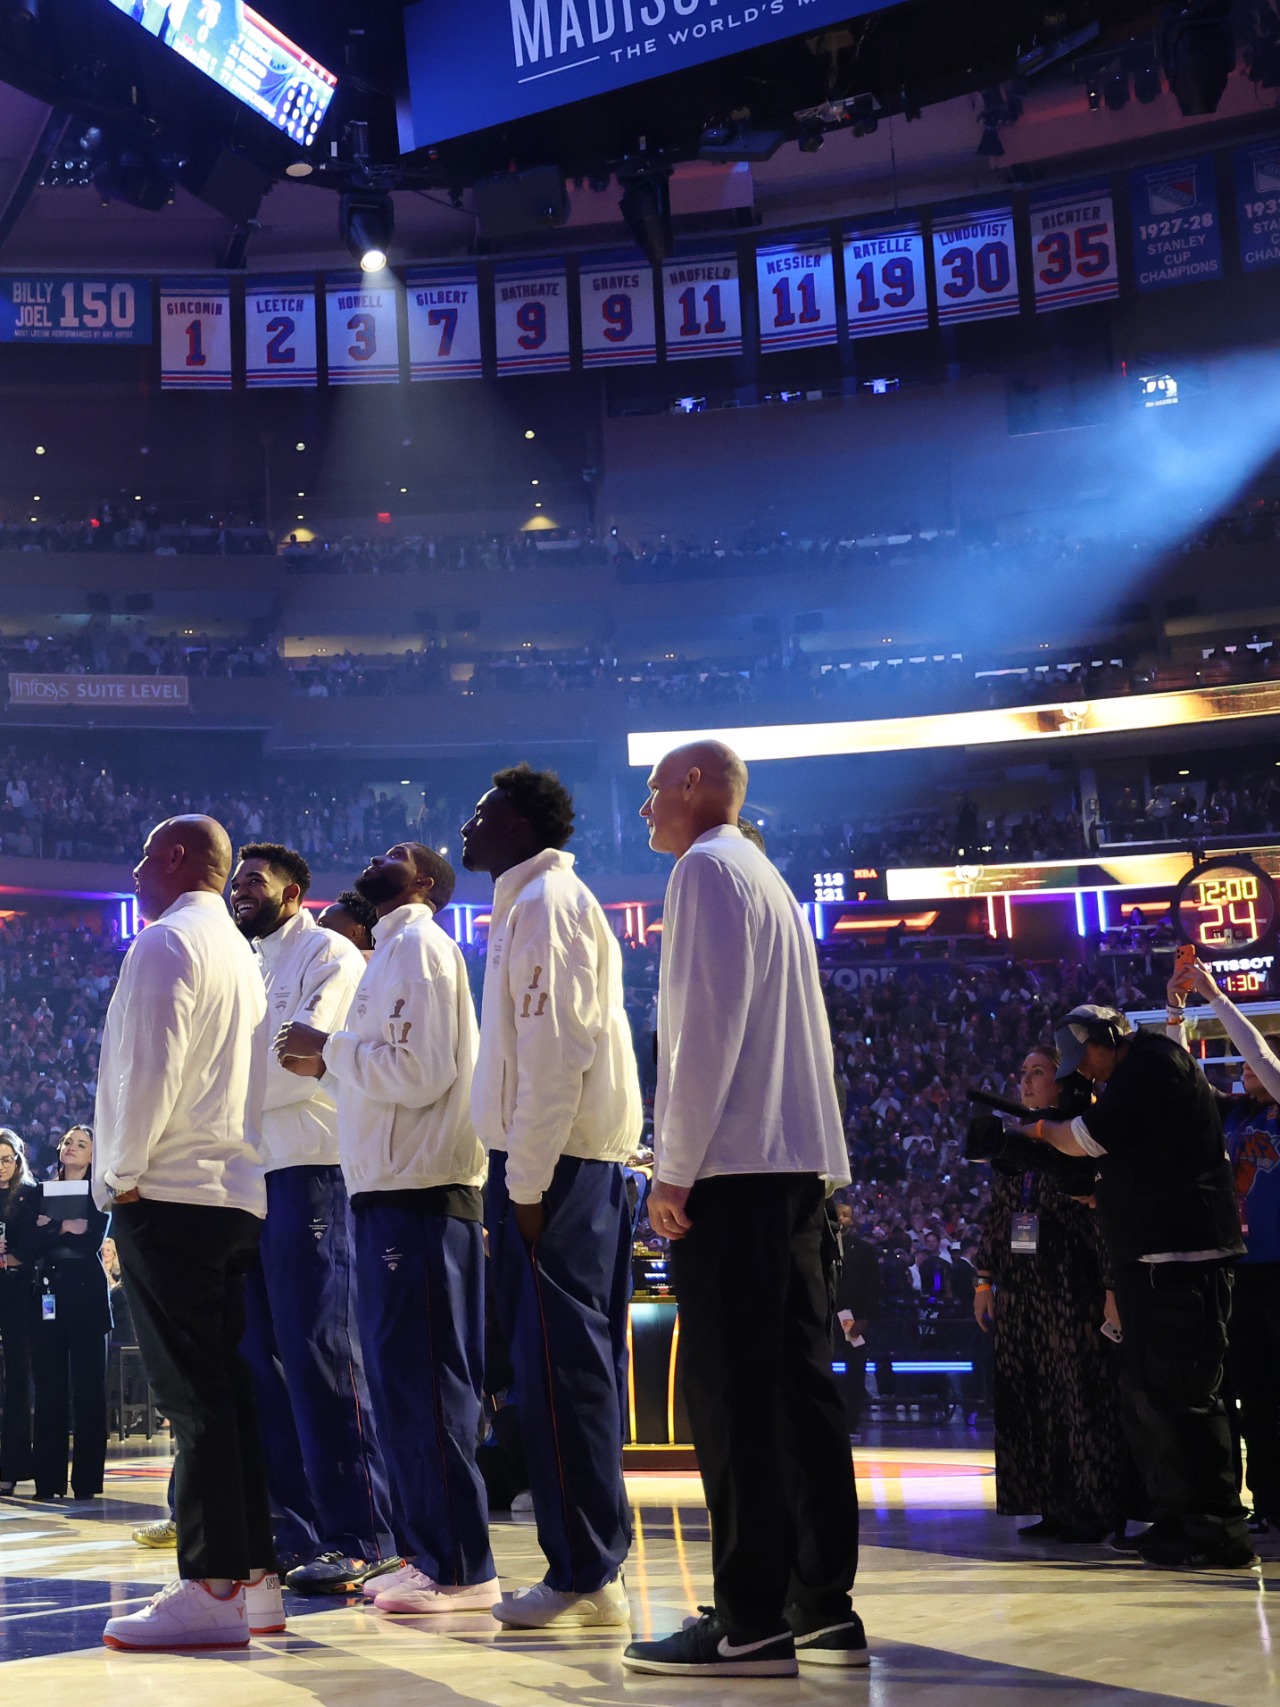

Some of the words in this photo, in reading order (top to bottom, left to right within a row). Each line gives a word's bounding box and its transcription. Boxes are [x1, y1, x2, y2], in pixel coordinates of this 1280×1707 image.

[610, 38, 657, 63] THE
[668, 0, 784, 45] WORLD'S
[1041, 206, 1101, 230] RICHTER
[1140, 213, 1214, 240] 1927-28
[853, 238, 912, 259] RATELLE
[1037, 223, 1110, 285] 35
[1147, 234, 1206, 255] STANLEY
[766, 255, 821, 275] MESSIER
[942, 241, 1010, 298] 30
[1164, 252, 1191, 266] CUP
[592, 275, 639, 291] GRAVES
[670, 267, 731, 284] HADFIELD
[1140, 260, 1218, 284] CHAMPIONS
[12, 282, 54, 303] BILLY
[501, 283, 560, 301] BATHGATE
[856, 257, 915, 313] 19
[60, 282, 135, 328] 150
[167, 301, 223, 315] GIACOMIN
[256, 299, 304, 314] LEETCH
[338, 295, 383, 310] HOWELL
[416, 291, 468, 306] GILBERT
[773, 273, 820, 327] 11
[15, 306, 52, 327] JOEL
[602, 294, 633, 342] 9
[678, 285, 726, 336] 11
[428, 308, 458, 356] 7
[516, 301, 546, 350] 9
[185, 319, 206, 366] 1
[266, 316, 295, 364] 2
[347, 313, 376, 361] 3
[15, 678, 68, 698] Infosys
[77, 683, 125, 698] SUITE
[131, 683, 181, 699] LEVEL
[813, 872, 844, 887] 113
[853, 869, 878, 879] NBA
[815, 888, 844, 902] 121
[1200, 876, 1258, 905] 12:00
[1197, 901, 1258, 944] 24
[1212, 956, 1274, 972] TISSOT
[1227, 974, 1259, 991] 1:30
